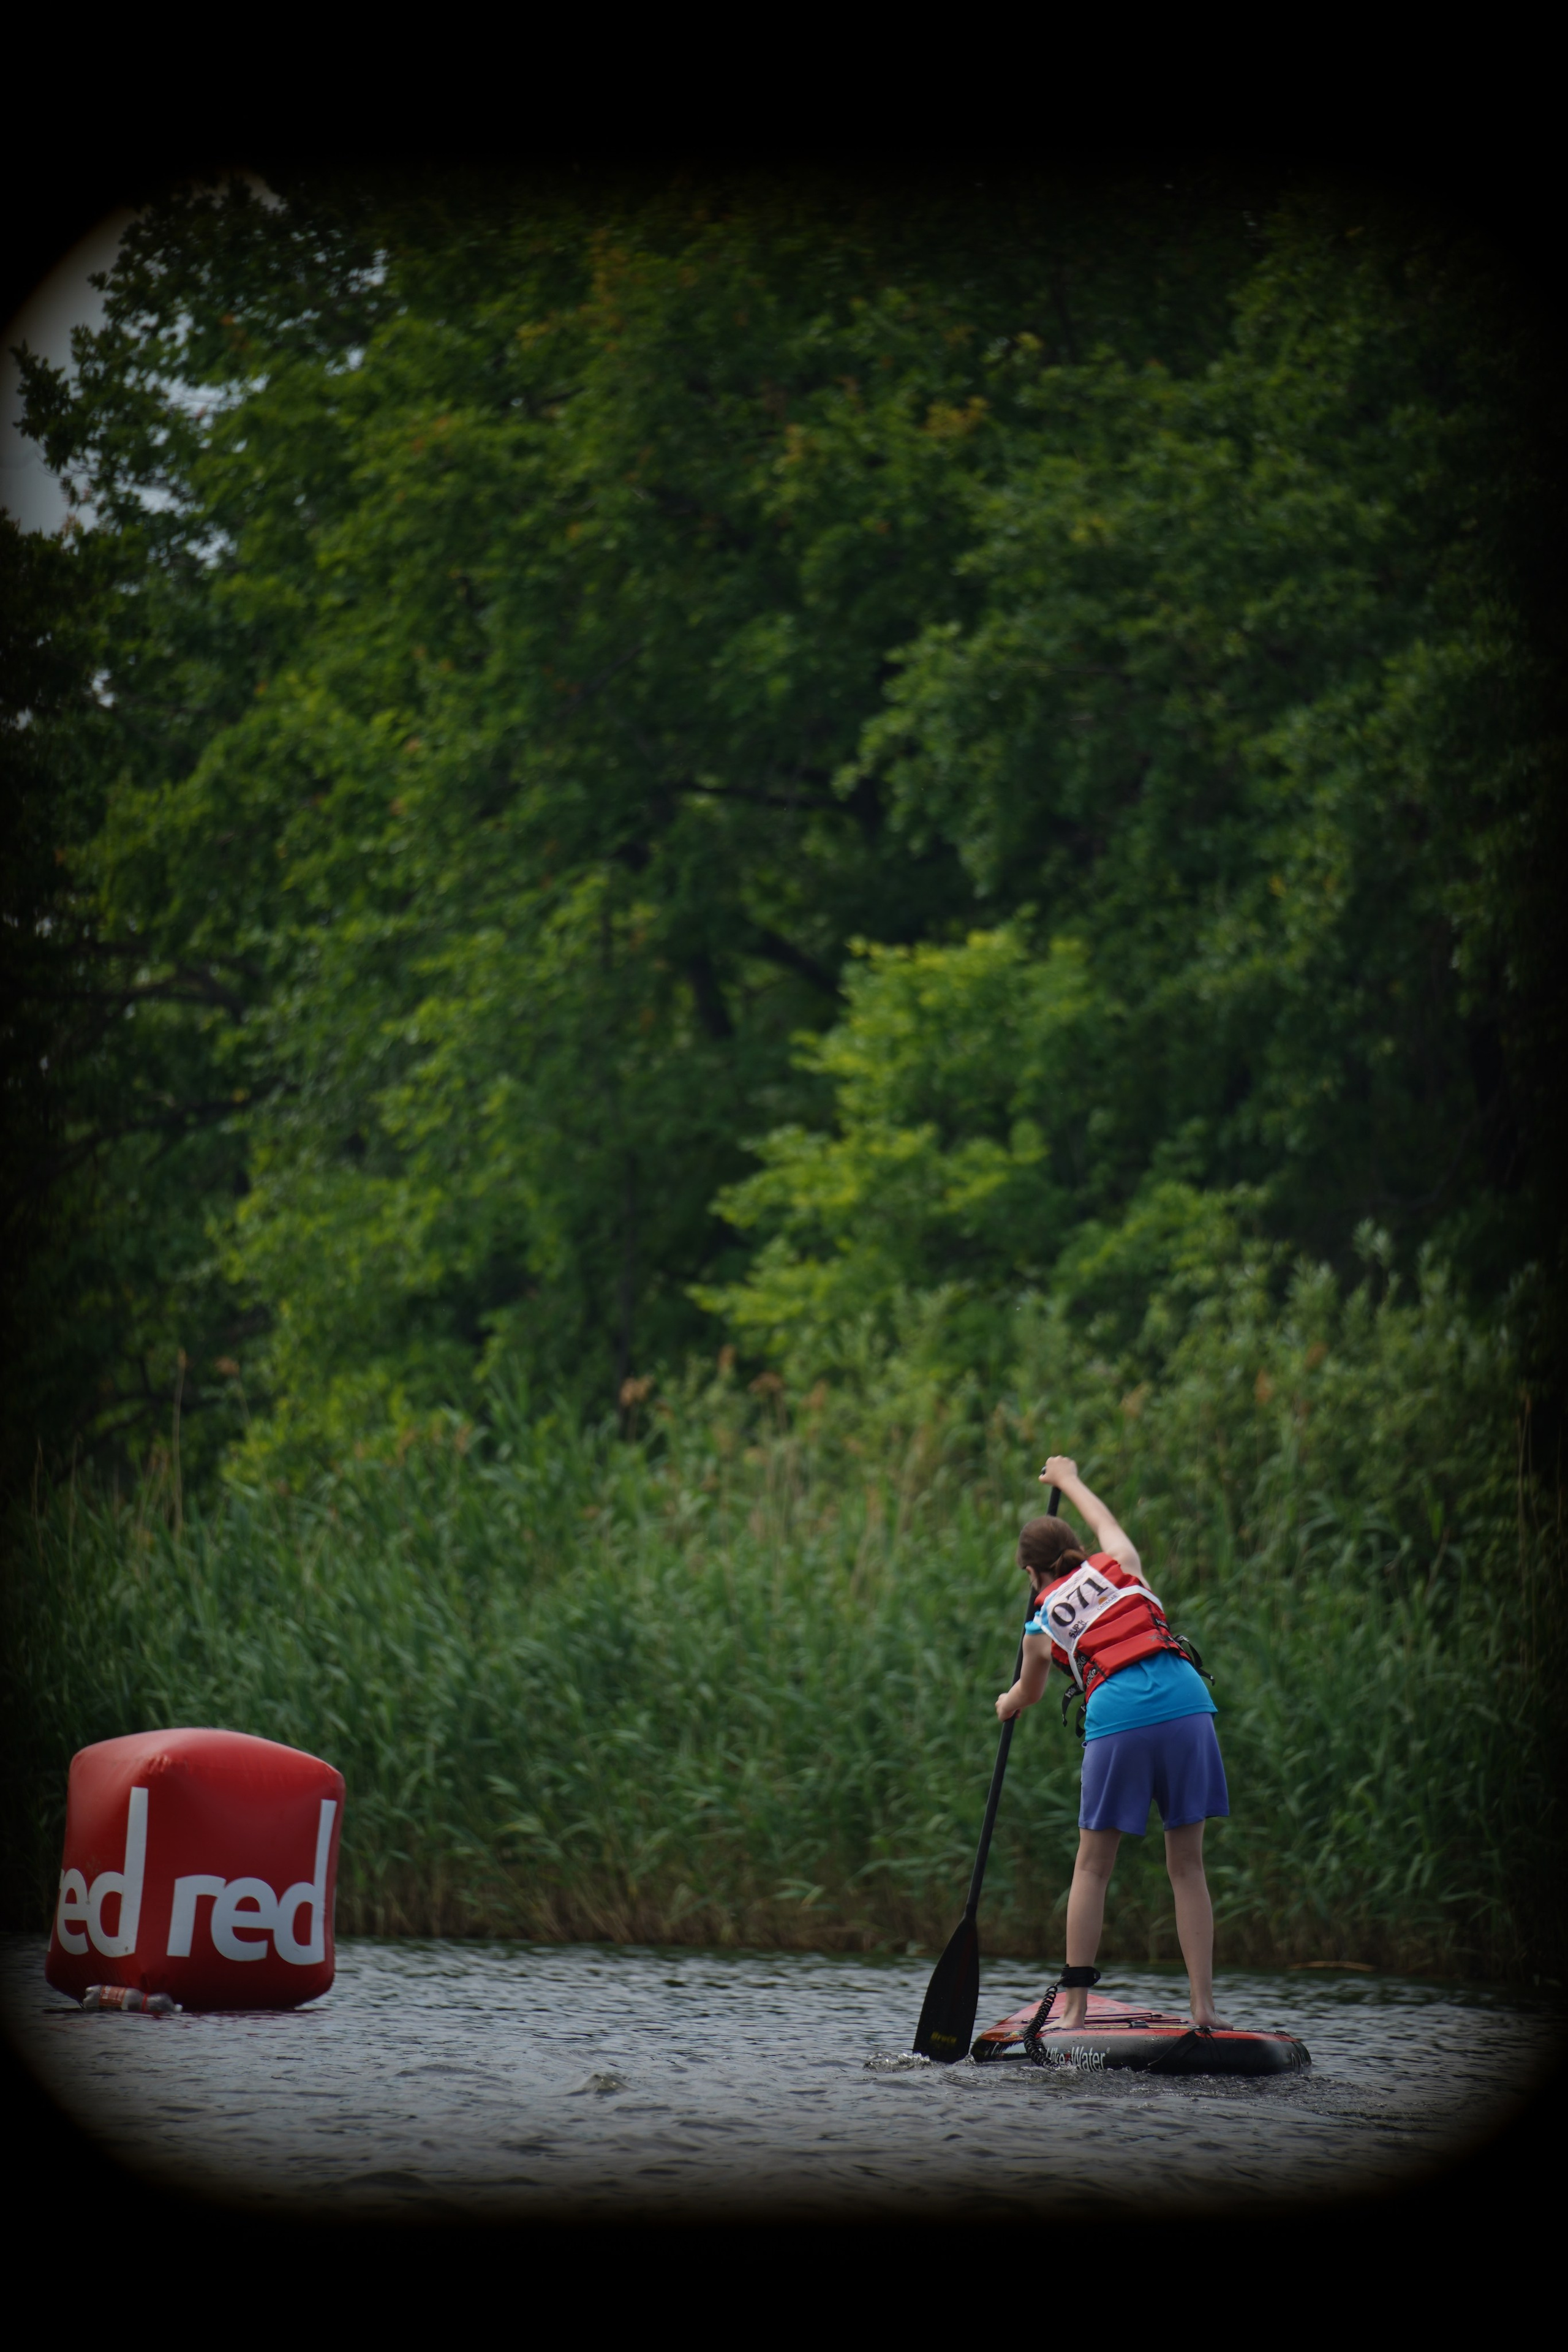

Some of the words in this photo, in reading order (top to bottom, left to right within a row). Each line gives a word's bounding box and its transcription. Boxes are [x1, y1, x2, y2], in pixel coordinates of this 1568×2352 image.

[1052, 1577, 1109, 1627] 071
[1068, 1624, 1080, 1638] SUP
[48, 1787, 148, 1958] ed
[167, 1799, 337, 1966] red
[1071, 2046, 1106, 2073] Water
